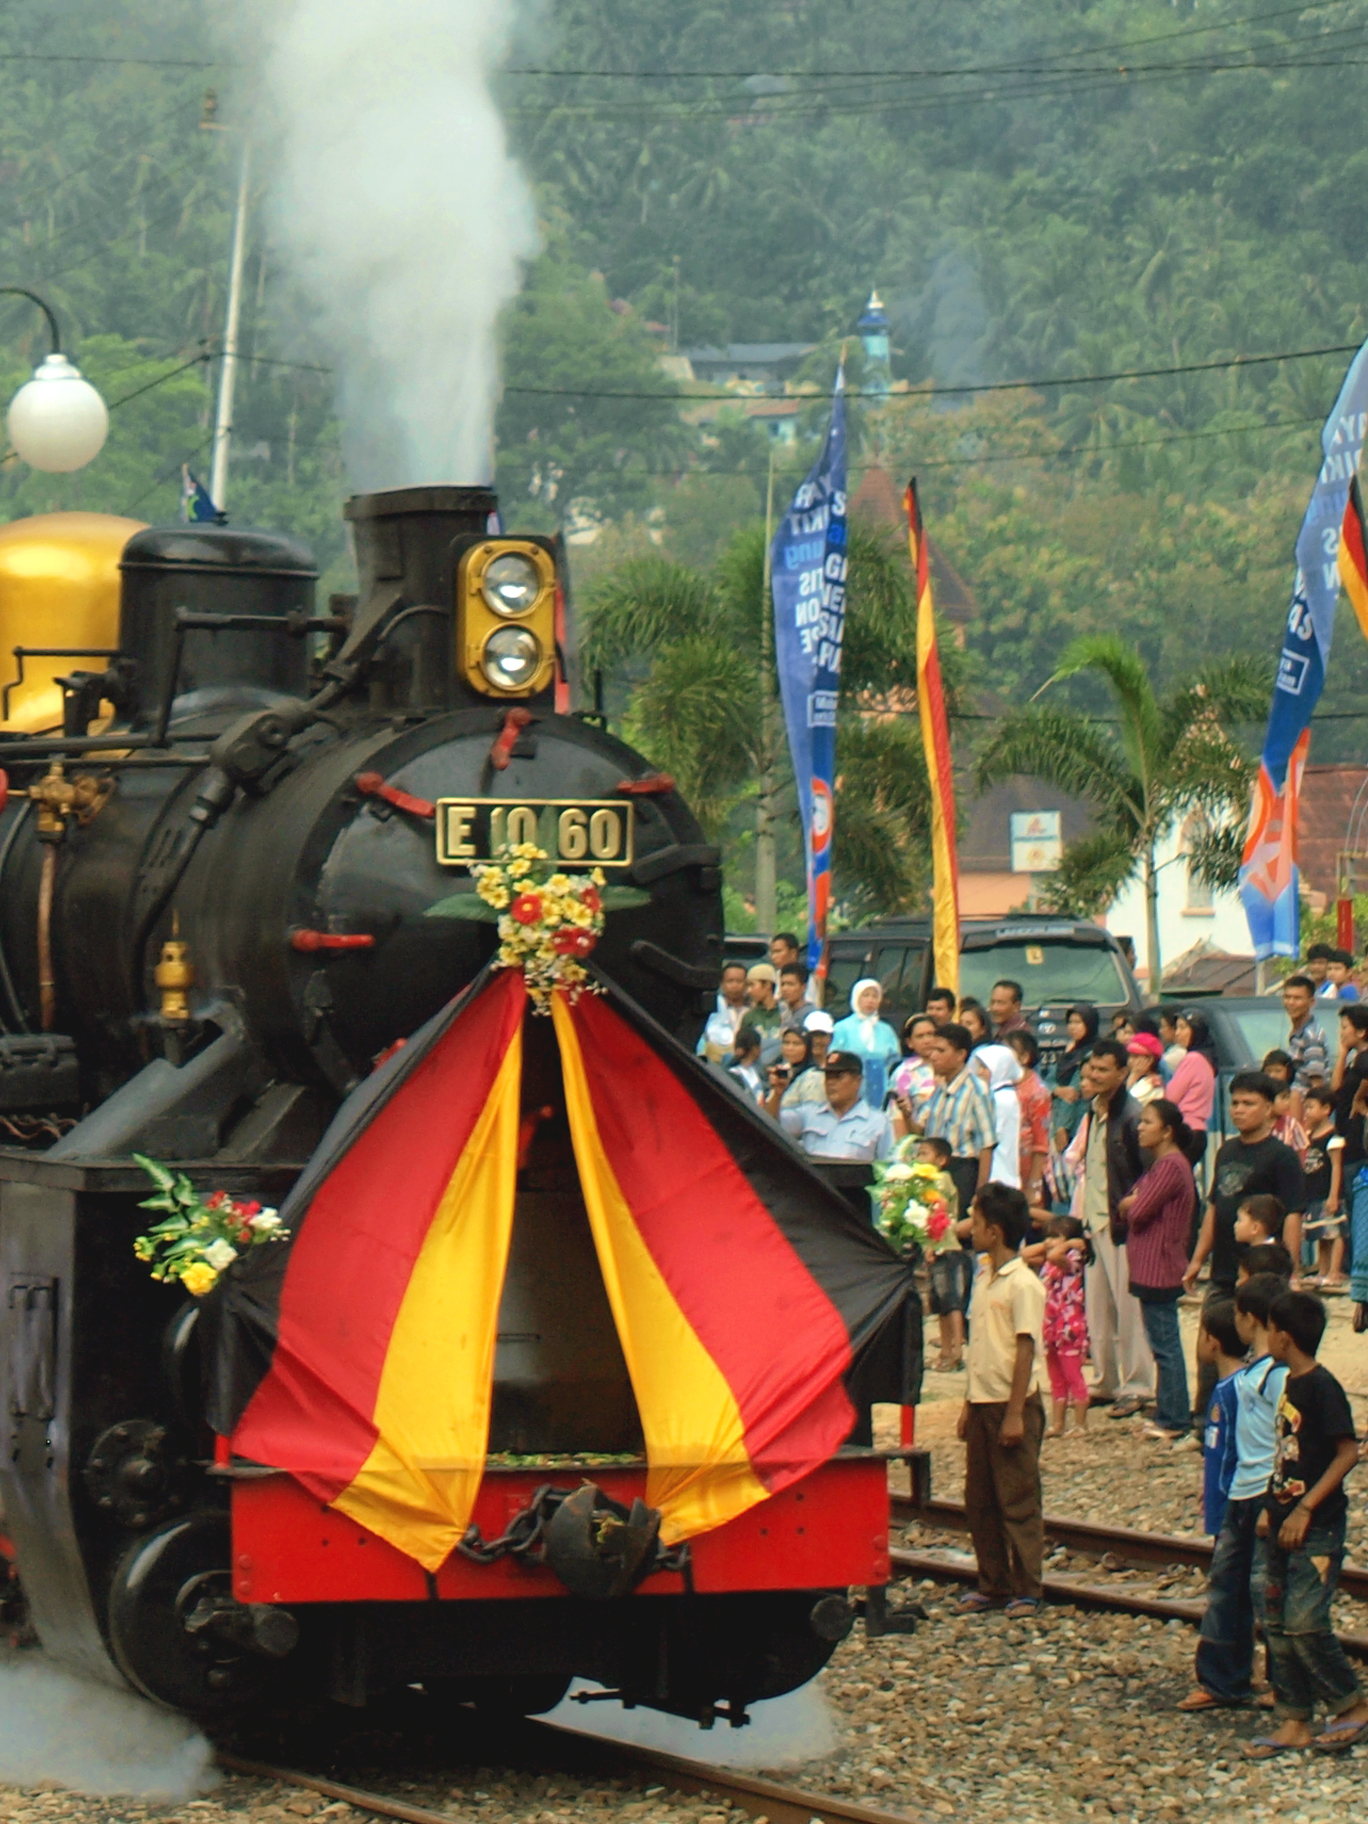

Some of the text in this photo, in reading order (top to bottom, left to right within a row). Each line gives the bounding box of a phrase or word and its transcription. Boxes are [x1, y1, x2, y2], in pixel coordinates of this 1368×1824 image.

[447, 806, 621, 860] E 10 60
